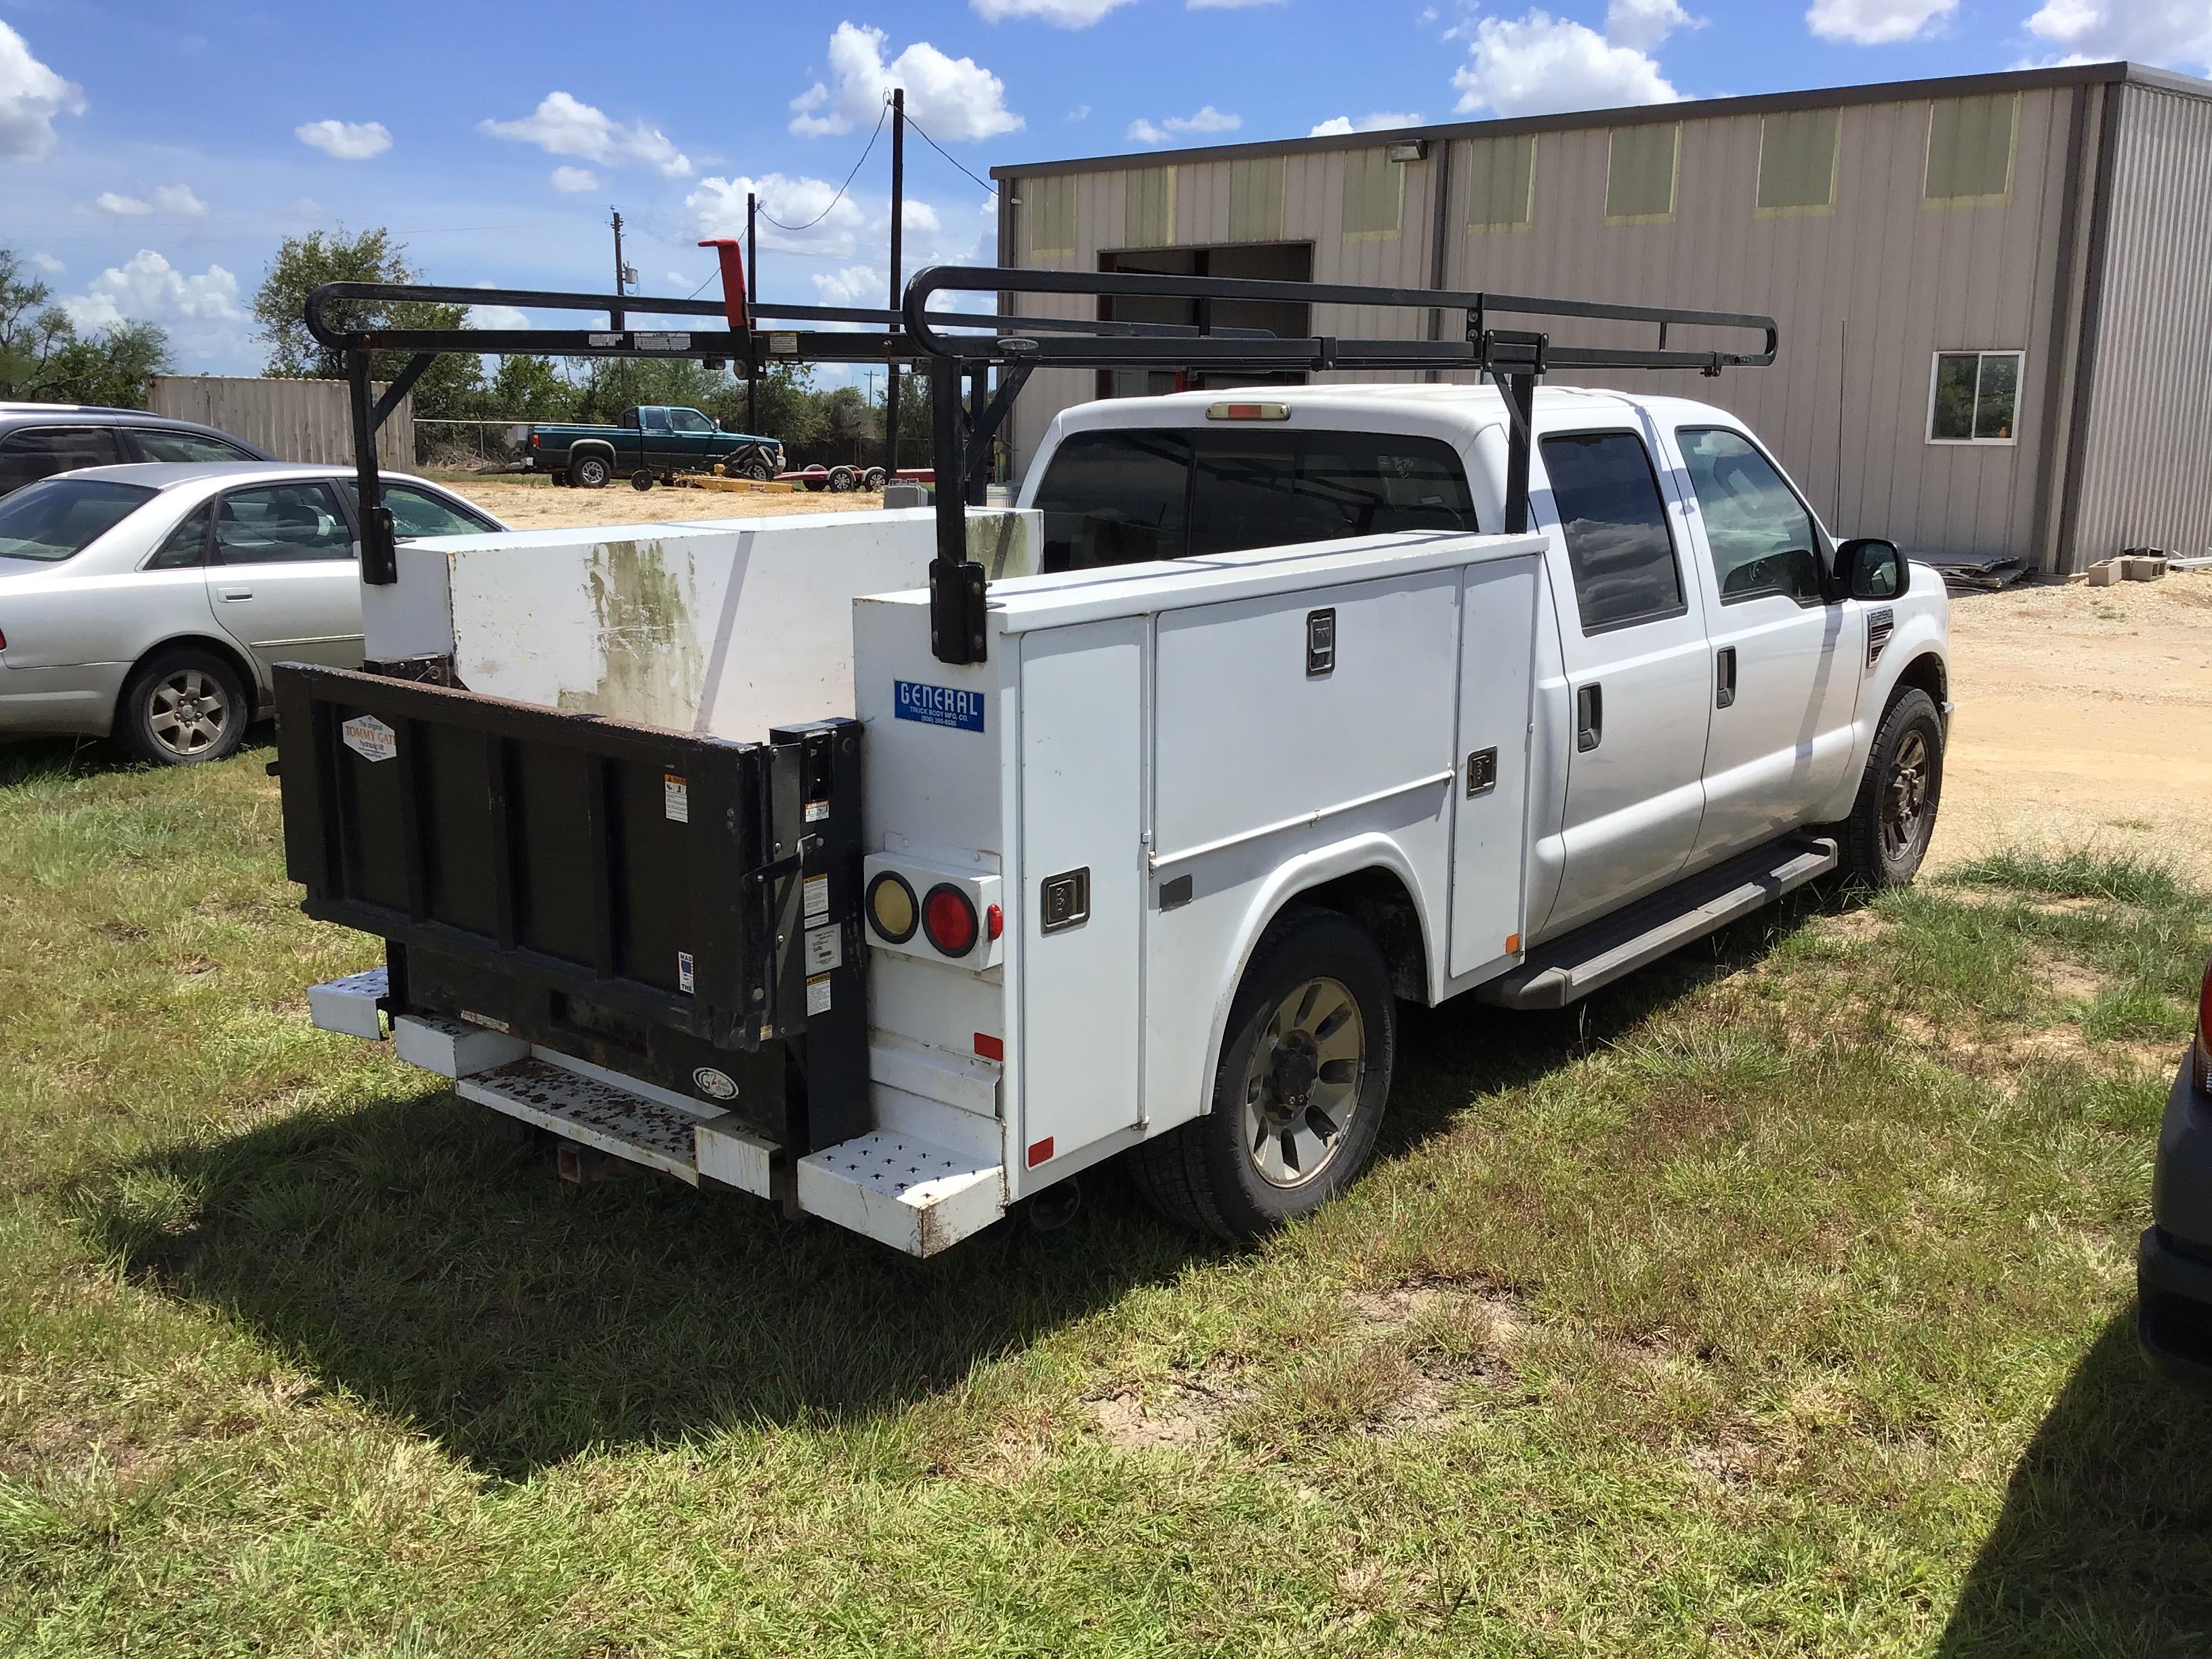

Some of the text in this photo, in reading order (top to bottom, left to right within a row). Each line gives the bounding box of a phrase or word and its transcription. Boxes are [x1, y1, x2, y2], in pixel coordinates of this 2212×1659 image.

[901, 682, 978, 716] GENERAL
[909, 706, 928, 715] TRUCK
[928, 709, 944, 717] BODY
[346, 725, 375, 741] TOMMY
[681, 983, 692, 991] THE
